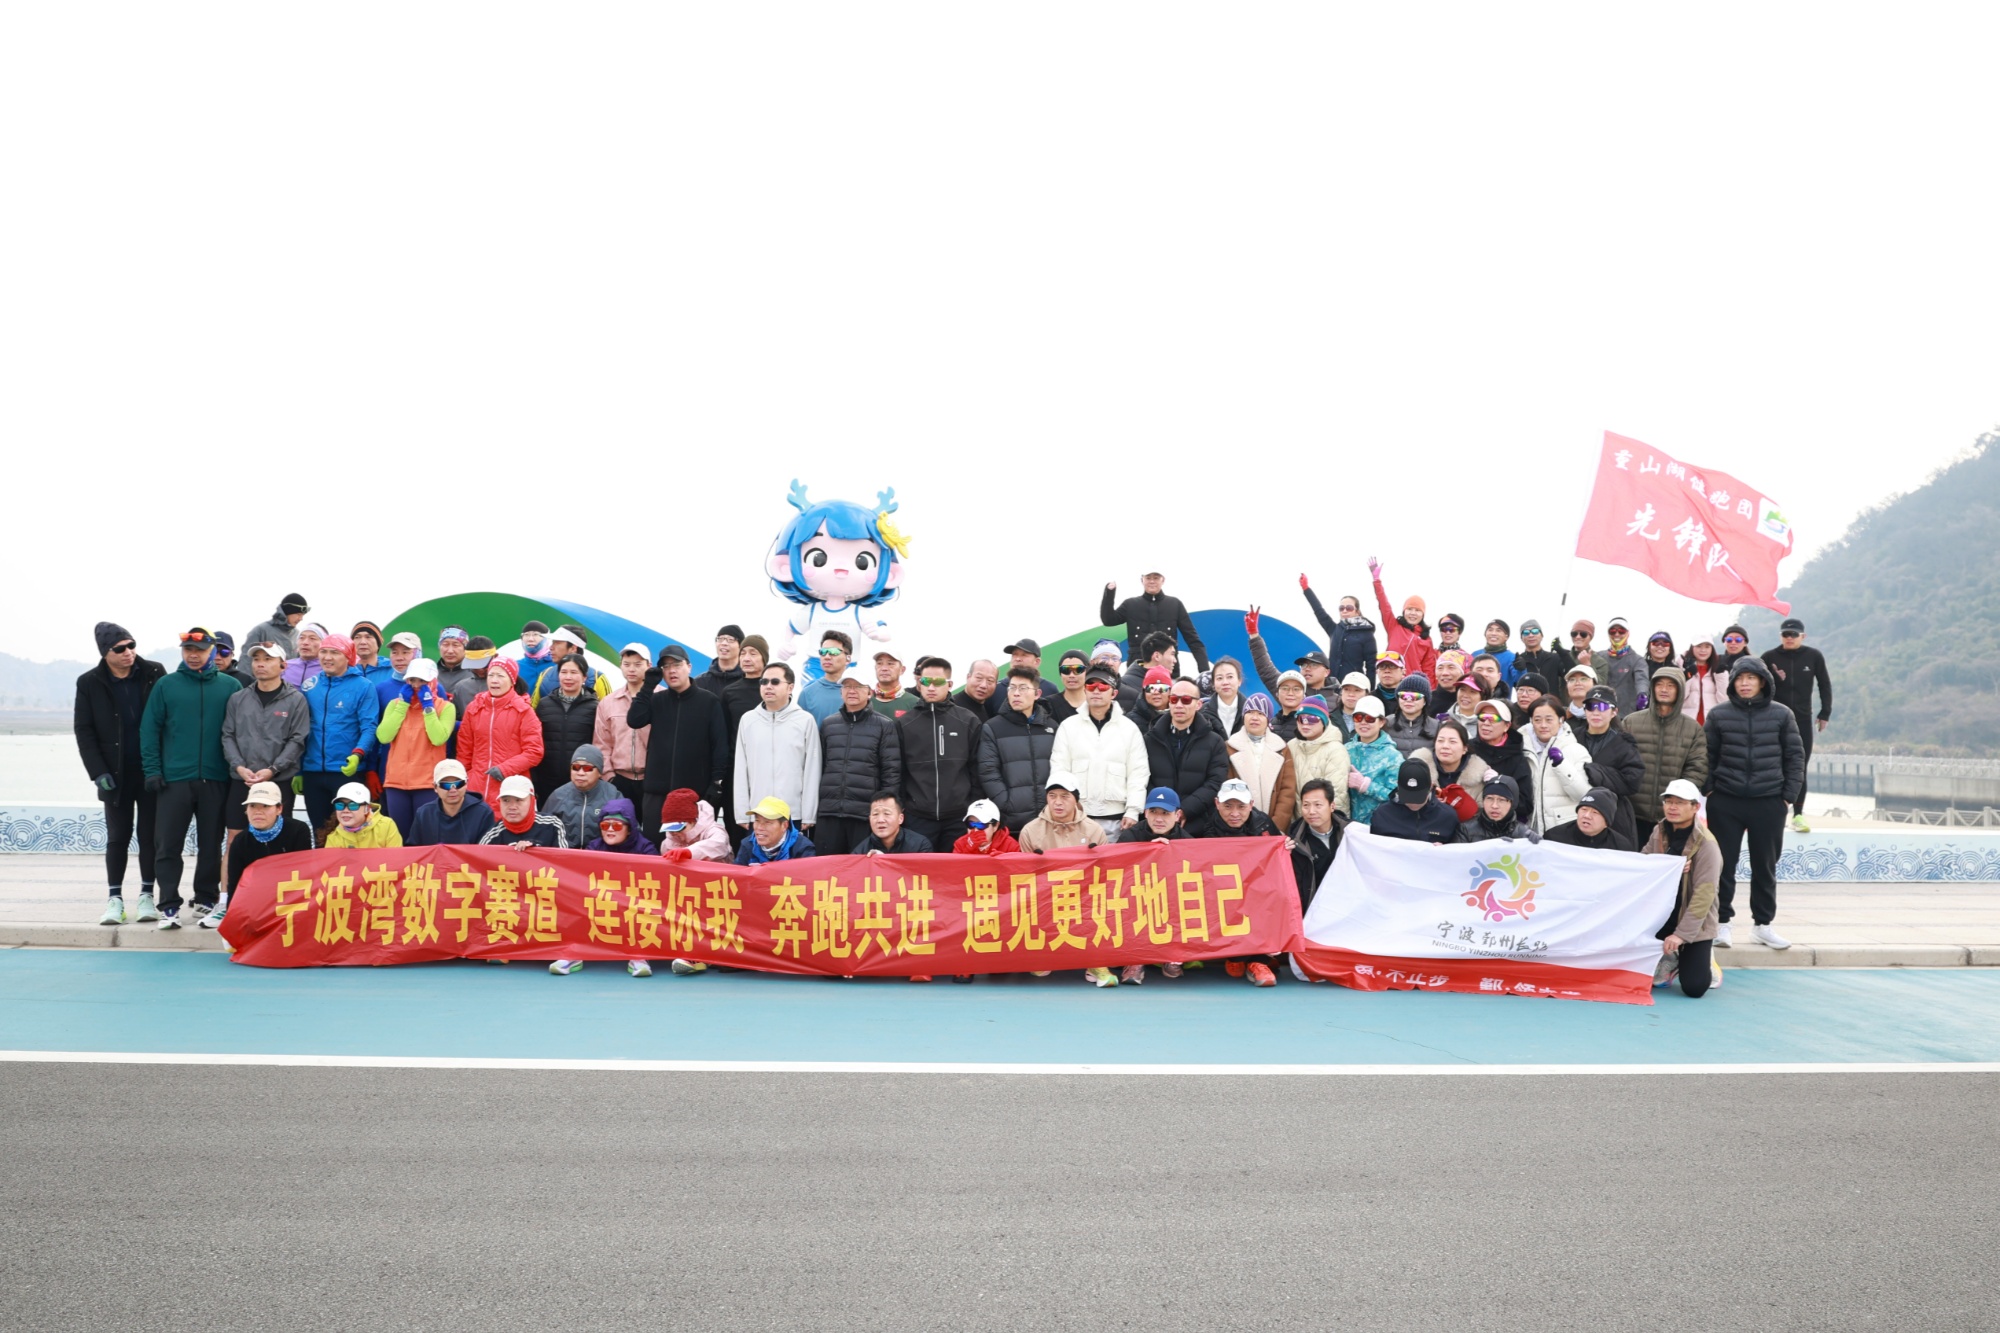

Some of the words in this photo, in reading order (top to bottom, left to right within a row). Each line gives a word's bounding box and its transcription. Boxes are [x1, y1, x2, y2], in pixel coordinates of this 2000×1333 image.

[1625, 503, 1743, 582] 先锋队
[276, 864, 560, 946] 宁波湾数字赛道
[584, 872, 743, 951] 连接你我
[770, 876, 935, 957] 奔跑共进
[963, 860, 1251, 953] 遇见更好地自己
[1432, 940, 1467, 952] NINGBO
[1468, 948, 1507, 958] YINZHOU
